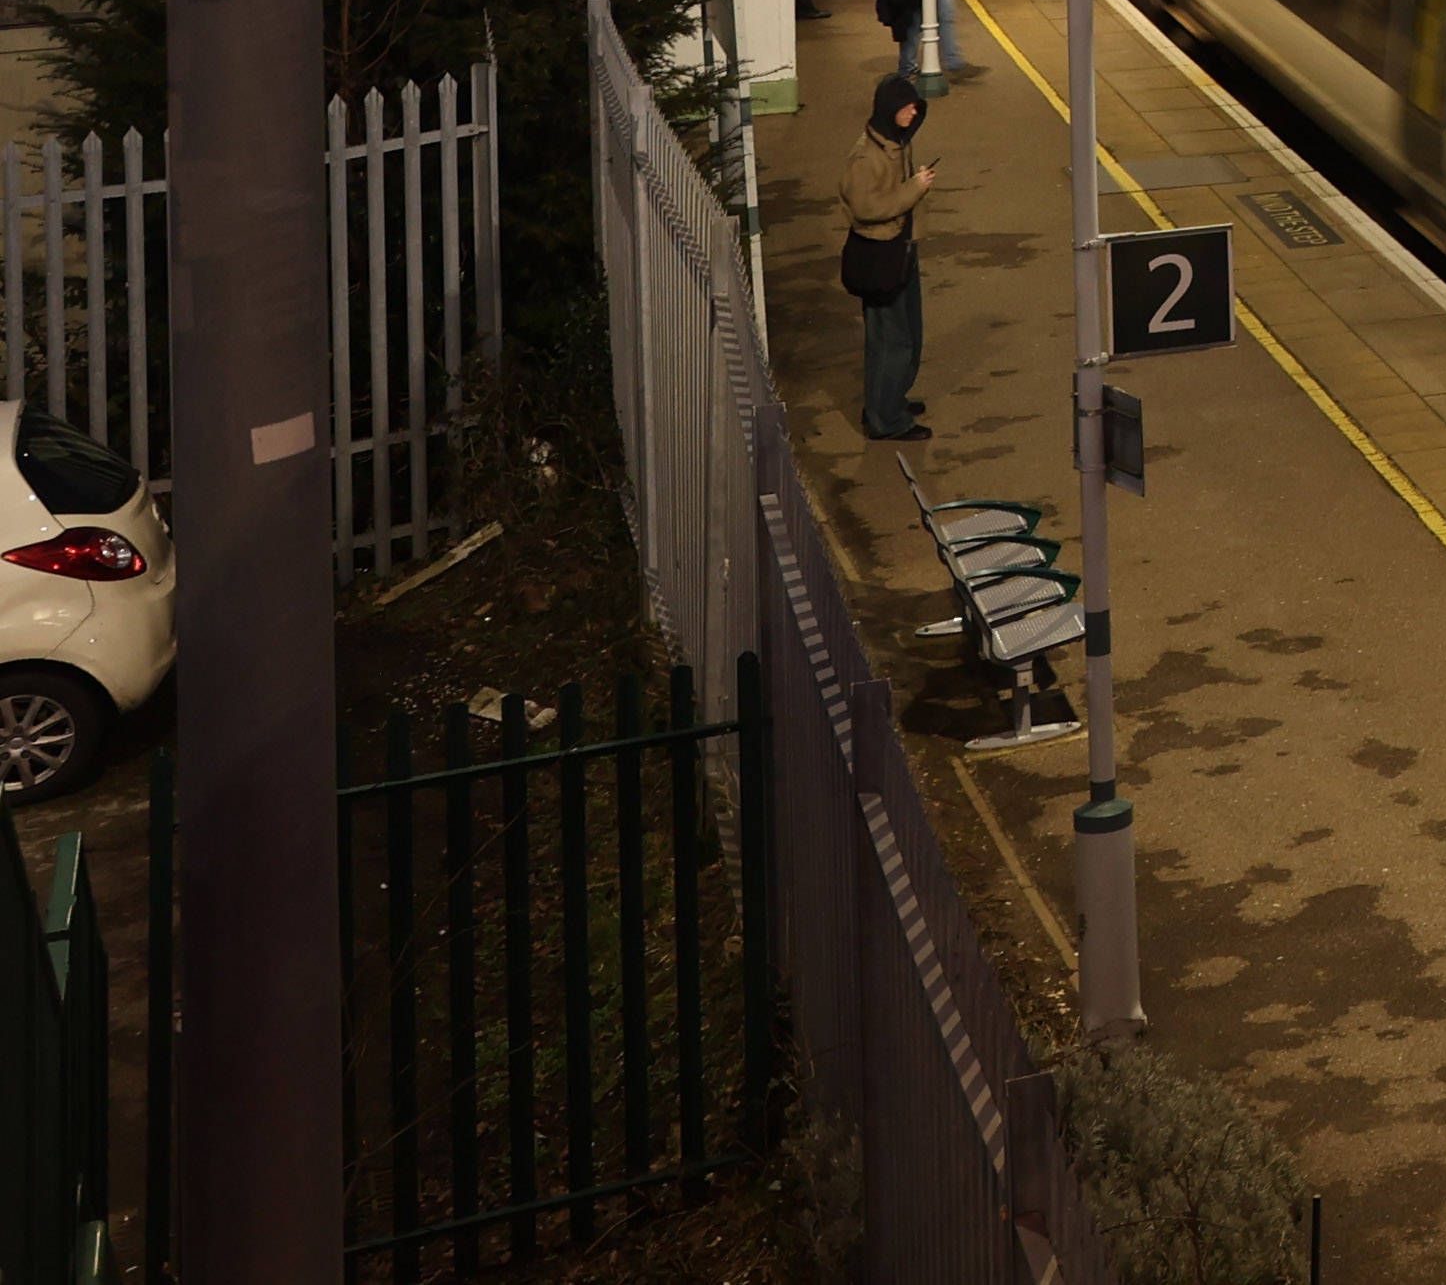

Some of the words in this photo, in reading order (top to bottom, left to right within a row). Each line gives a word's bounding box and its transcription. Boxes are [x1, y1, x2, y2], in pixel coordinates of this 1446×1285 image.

[1269, 210, 1309, 227] THE
[1284, 225, 1329, 245] STEP
[1148, 253, 1195, 334] 2
